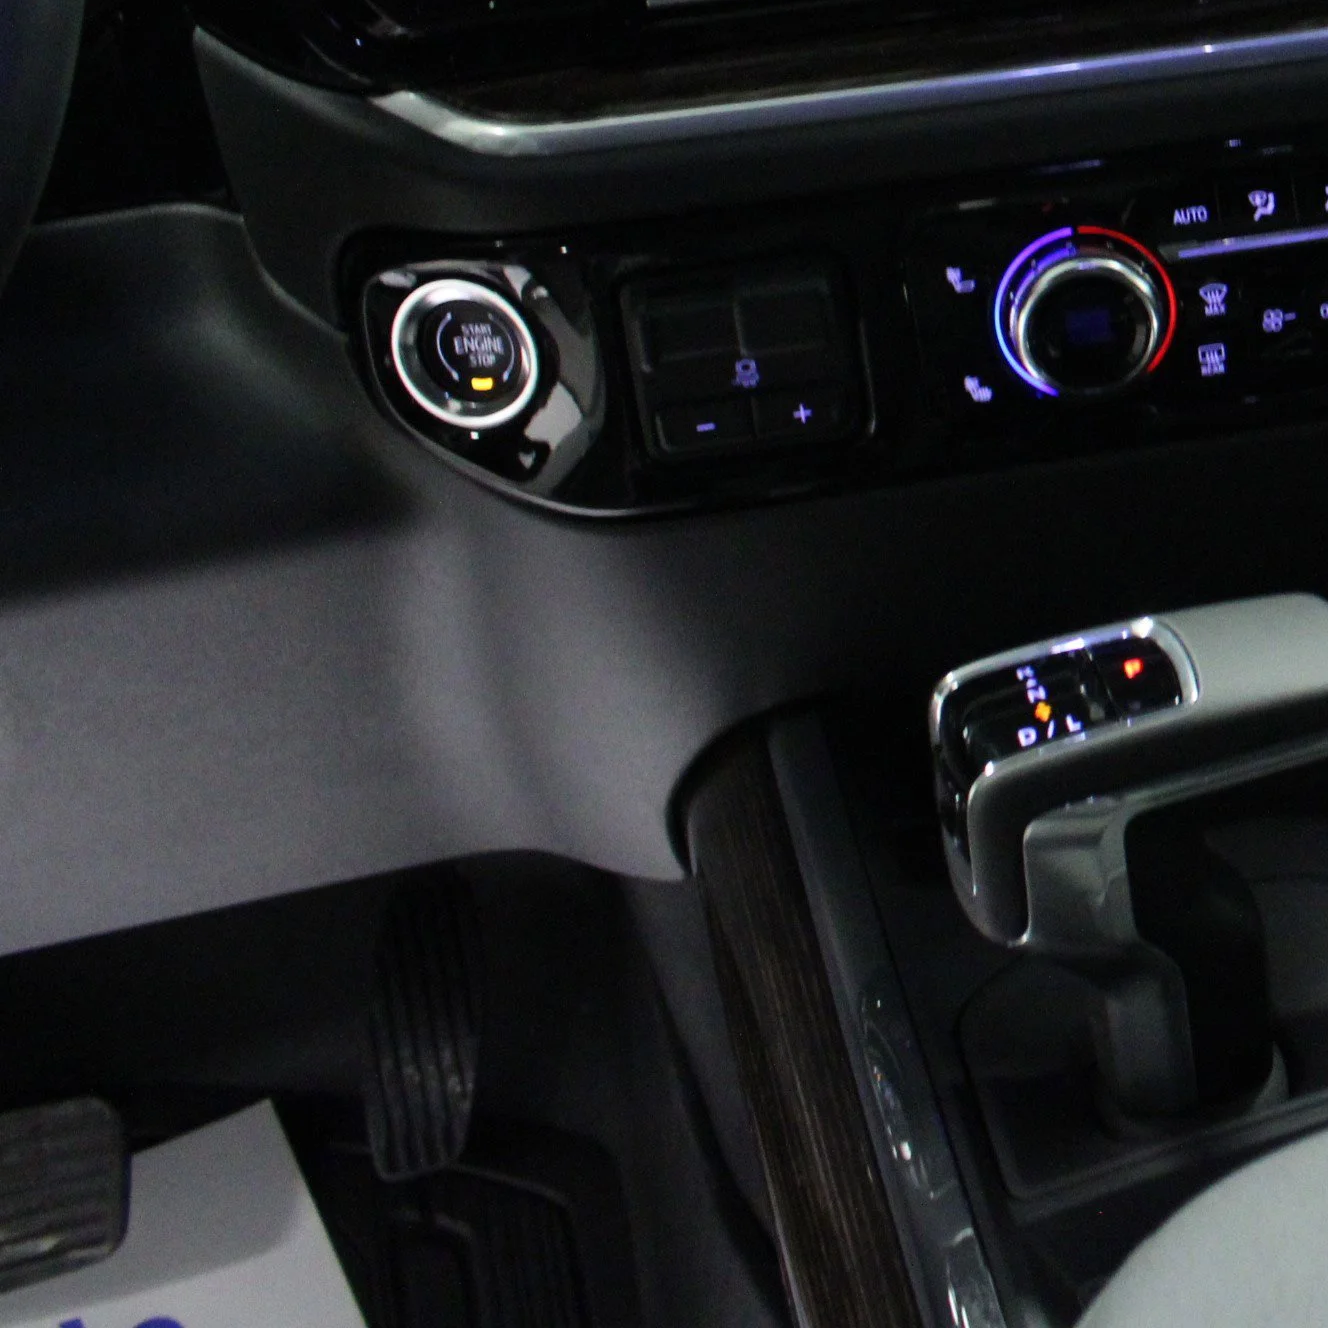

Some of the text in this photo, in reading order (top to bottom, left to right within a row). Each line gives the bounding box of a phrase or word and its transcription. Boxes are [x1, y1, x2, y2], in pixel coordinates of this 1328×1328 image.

[1173, 204, 1209, 226] AUTO
[461, 323, 492, 337] START
[453, 335, 504, 356] ENGINE
[469, 354, 496, 368] STOP
